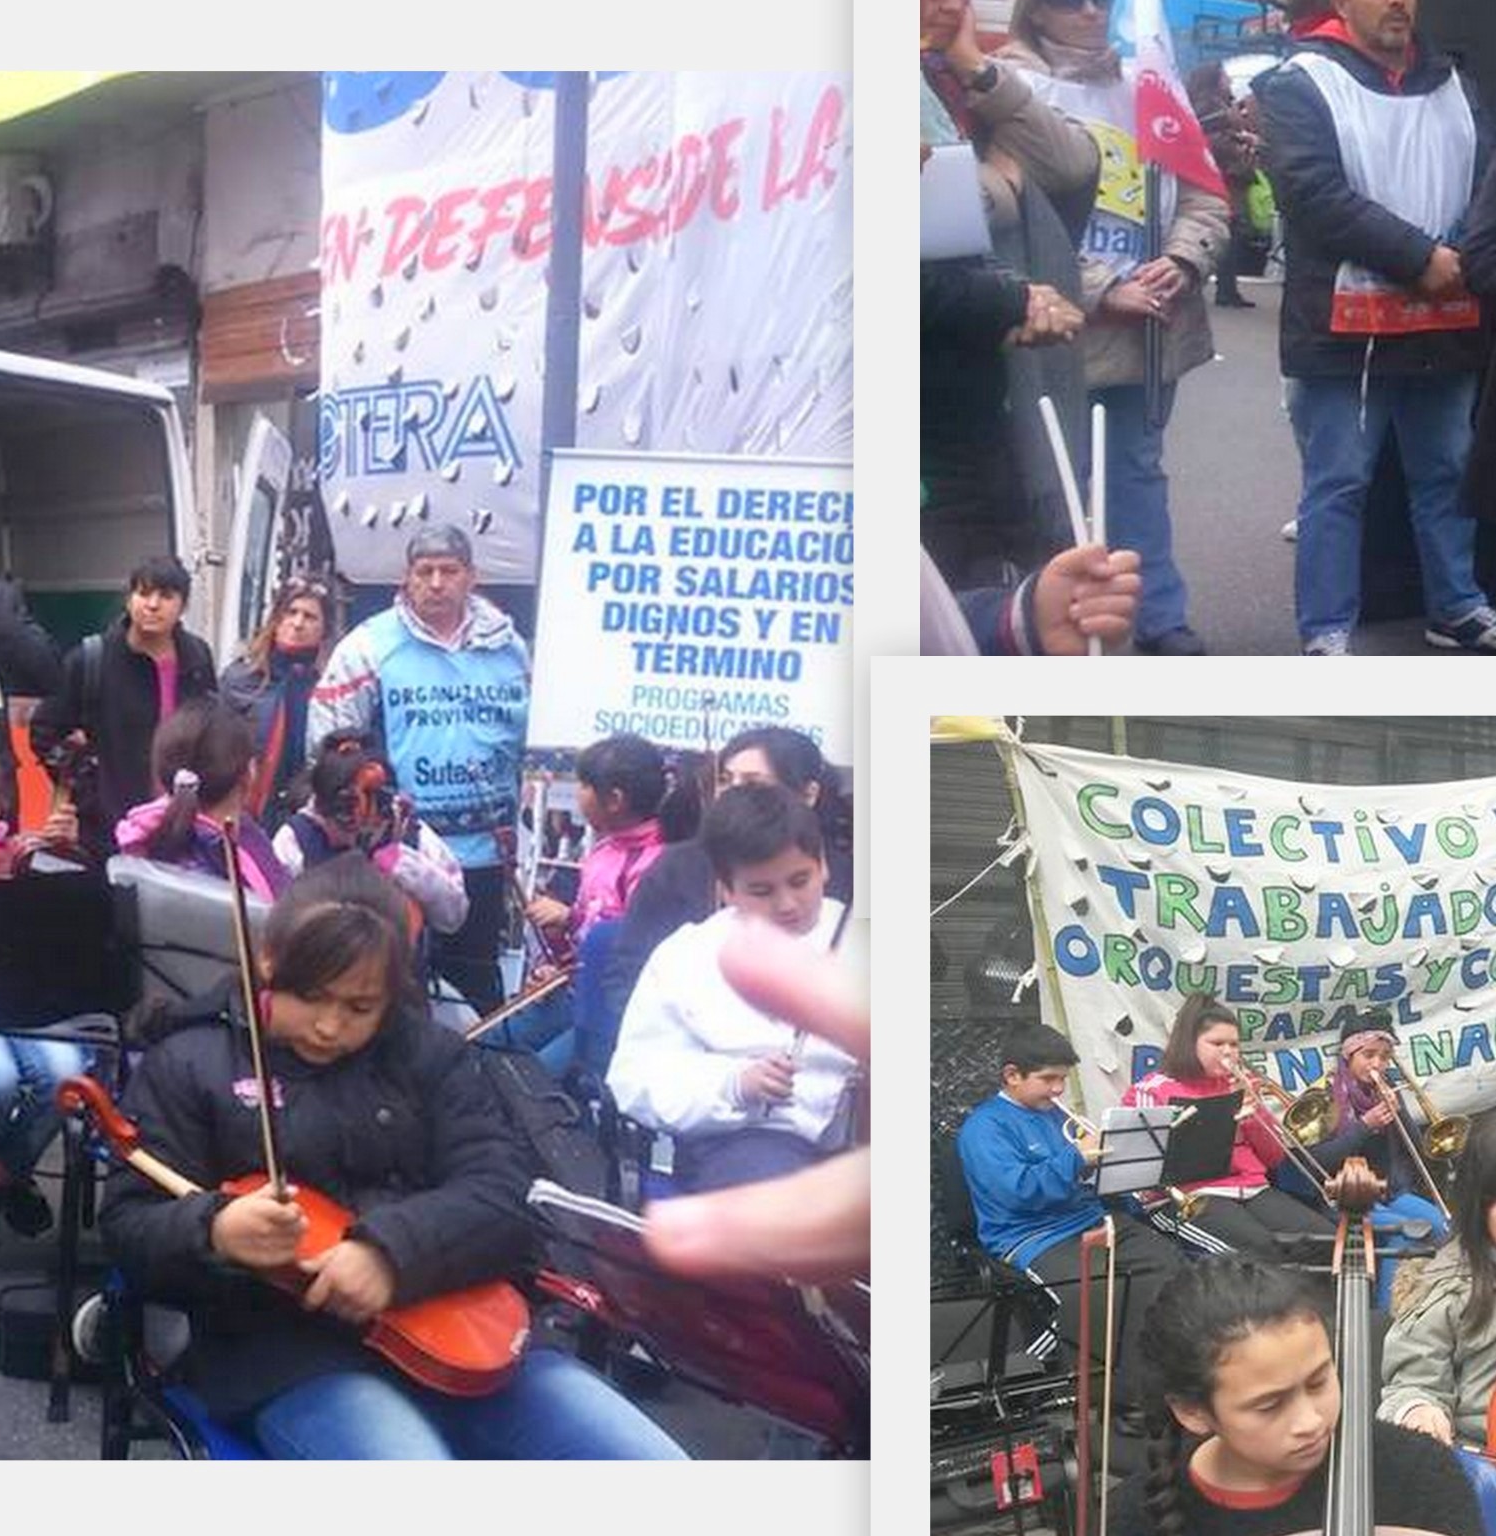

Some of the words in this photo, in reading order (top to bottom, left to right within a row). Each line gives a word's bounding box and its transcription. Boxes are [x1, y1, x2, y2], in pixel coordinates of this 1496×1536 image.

[761, 85, 845, 212] LA
[573, 483, 647, 516] POR
[661, 487, 703, 518] EL
[572, 522, 597, 553] A
[610, 524, 654, 556] LA
[669, 527, 853, 564] EDUCACIÓ
[587, 561, 661, 595] POR
[675, 565, 853, 606] SALARIOS
[601, 601, 741, 639] DIGNOS
[753, 609, 778, 640] Y
[789, 610, 840, 644] EN
[632, 685, 790, 717] PROGRAMAS
[1076, 783, 1479, 865] COLECTIVO
[1054, 924, 1407, 1005] ORQUESTAS
[1421, 955, 1456, 994] Y
